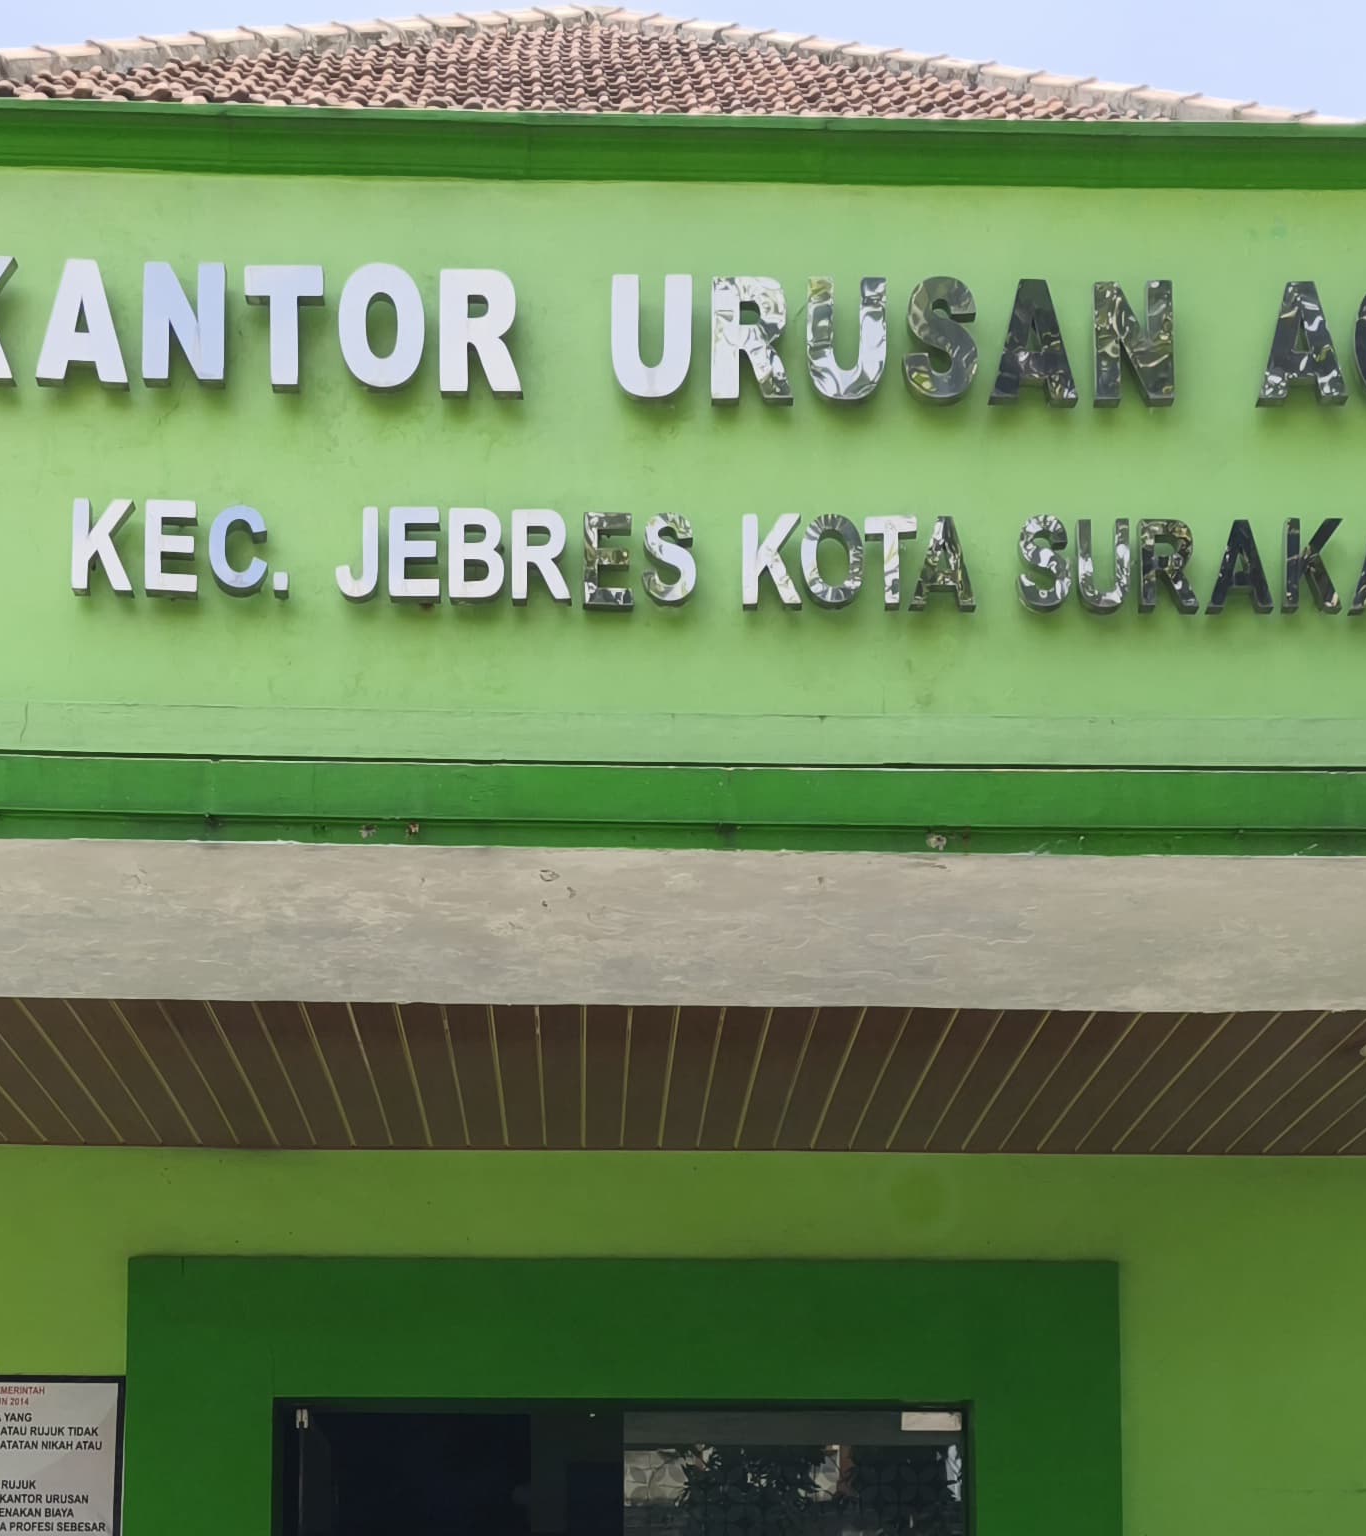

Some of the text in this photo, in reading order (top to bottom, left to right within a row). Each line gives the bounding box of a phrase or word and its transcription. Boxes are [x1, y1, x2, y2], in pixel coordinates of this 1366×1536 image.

[610, 273, 1176, 408] URUSAN
[71, 497, 289, 599] KEC.
[335, 506, 698, 612] JEBRES
[741, 512, 977, 613] KOTA
[10, 1397, 29, 1406] 2014
[4, 1412, 33, 1423] YANG
[0, 1426, 27, 1436] ATAU
[30, 1426, 65, 1436] RUJUK
[68, 1426, 99, 1437] TIDAK
[41, 1440, 73, 1450] NIKAH
[75, 1440, 103, 1450] ATAU
[1, 1479, 37, 1490] RUJUK
[0, 1493, 43, 1504] KANTOR
[45, 1494, 89, 1504] URUSAN
[44, 1507, 75, 1518] BIAYA
[9, 1521, 54, 1532] PROFESI
[56, 1521, 106, 1532] SEBESAR
